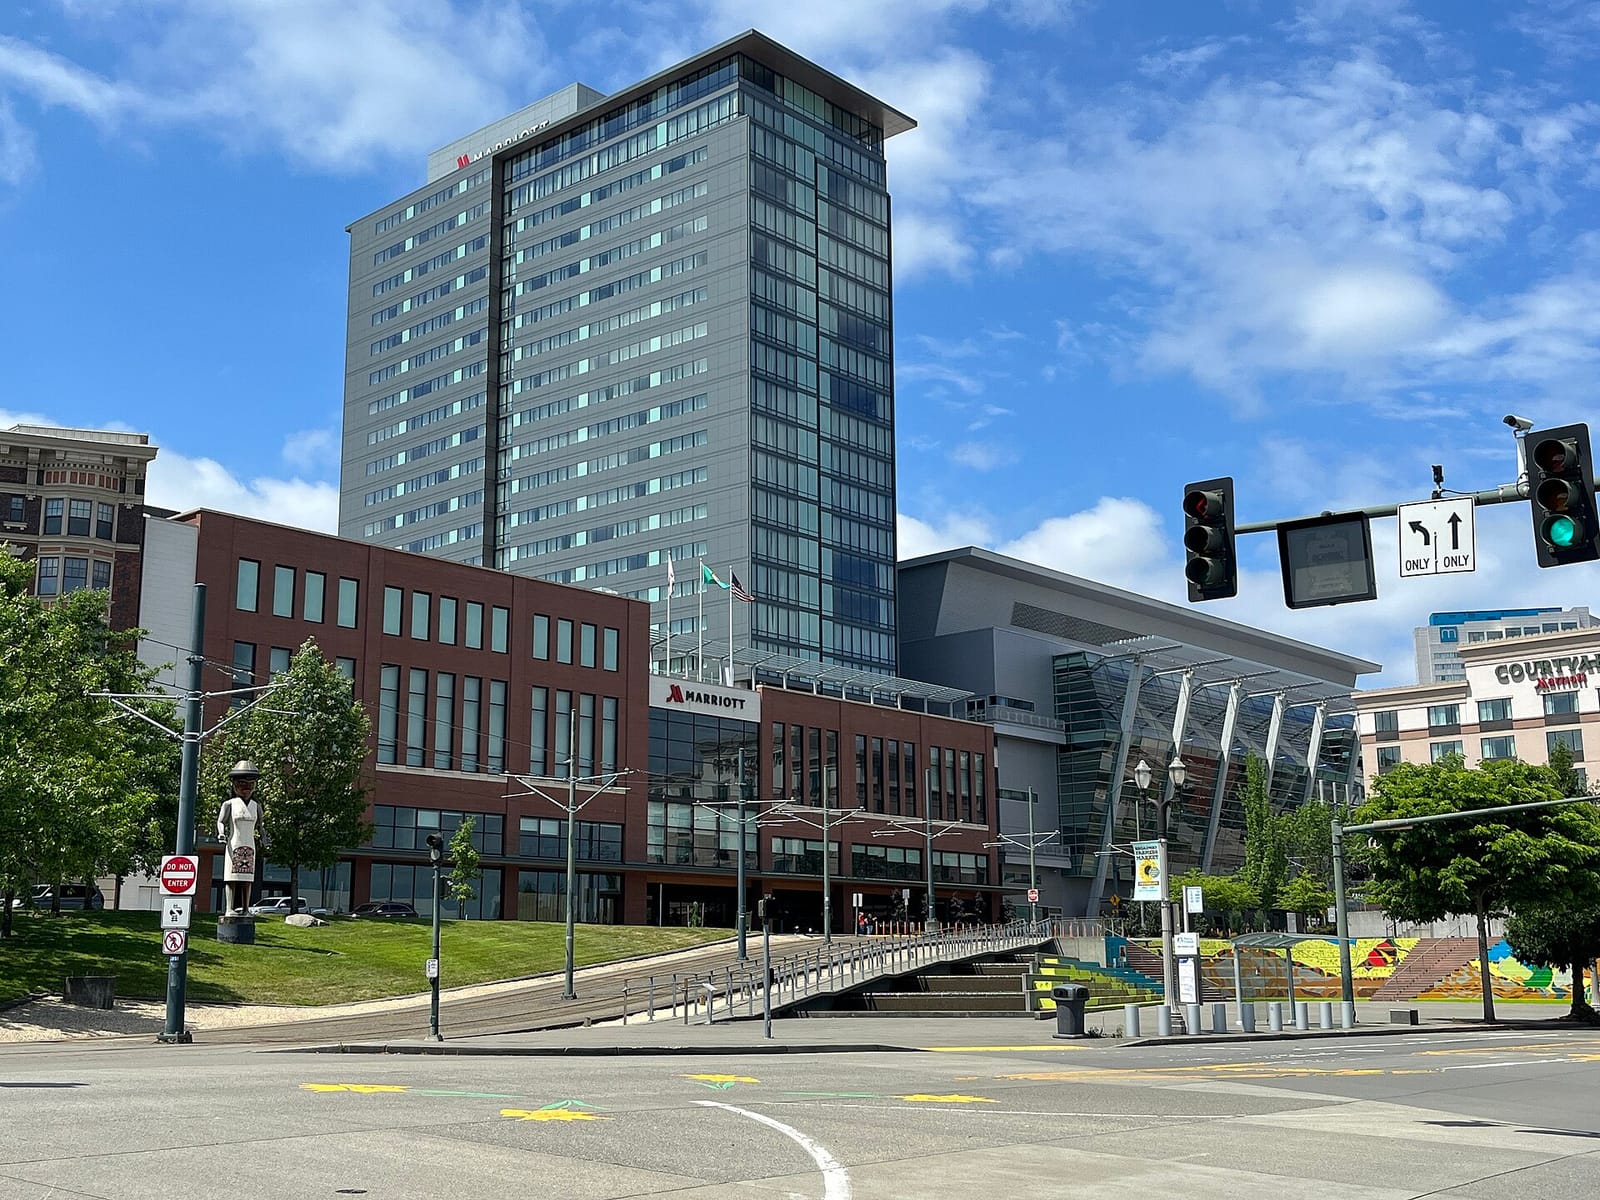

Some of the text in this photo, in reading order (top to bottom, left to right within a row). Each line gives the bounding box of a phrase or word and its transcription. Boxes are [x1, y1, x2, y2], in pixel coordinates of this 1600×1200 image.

[1405, 558, 1430, 572] ONLY
[1443, 554, 1470, 568] ONLY
[685, 690, 746, 709] MARRIOTT
[166, 863, 192, 871] DO NOT
[167, 879, 189, 887] ENTER
